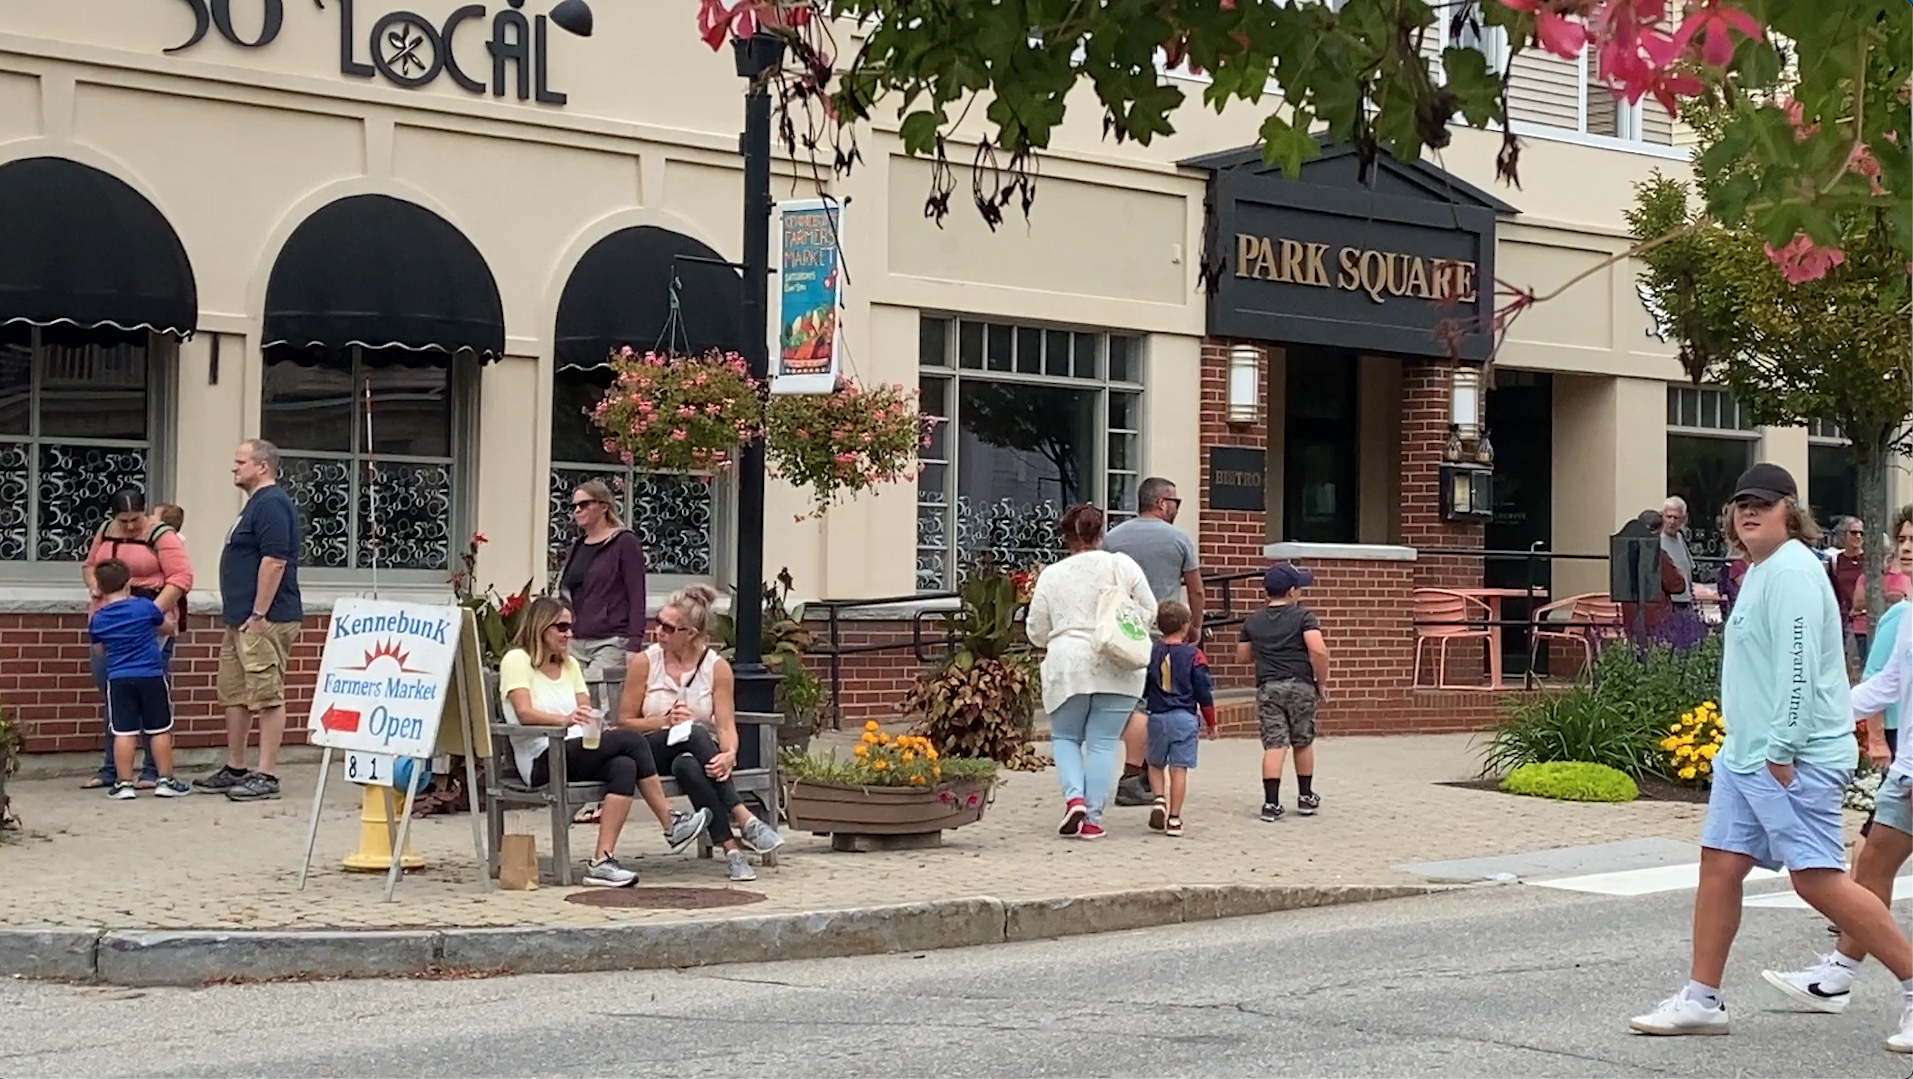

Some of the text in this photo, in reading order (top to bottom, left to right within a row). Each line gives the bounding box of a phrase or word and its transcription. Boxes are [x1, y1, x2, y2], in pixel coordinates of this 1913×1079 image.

[341, 0, 567, 105] LOCAL
[784, 247, 834, 269] MARKET
[1235, 233, 1476, 304] PARK SQUARE
[1215, 470, 1262, 487] BISTRO
[323, 673, 437, 701] Farmers Market
[1788, 616, 1807, 728] vineyard vines
[368, 705, 424, 747] Open
[348, 755, 379, 780] 8 1
